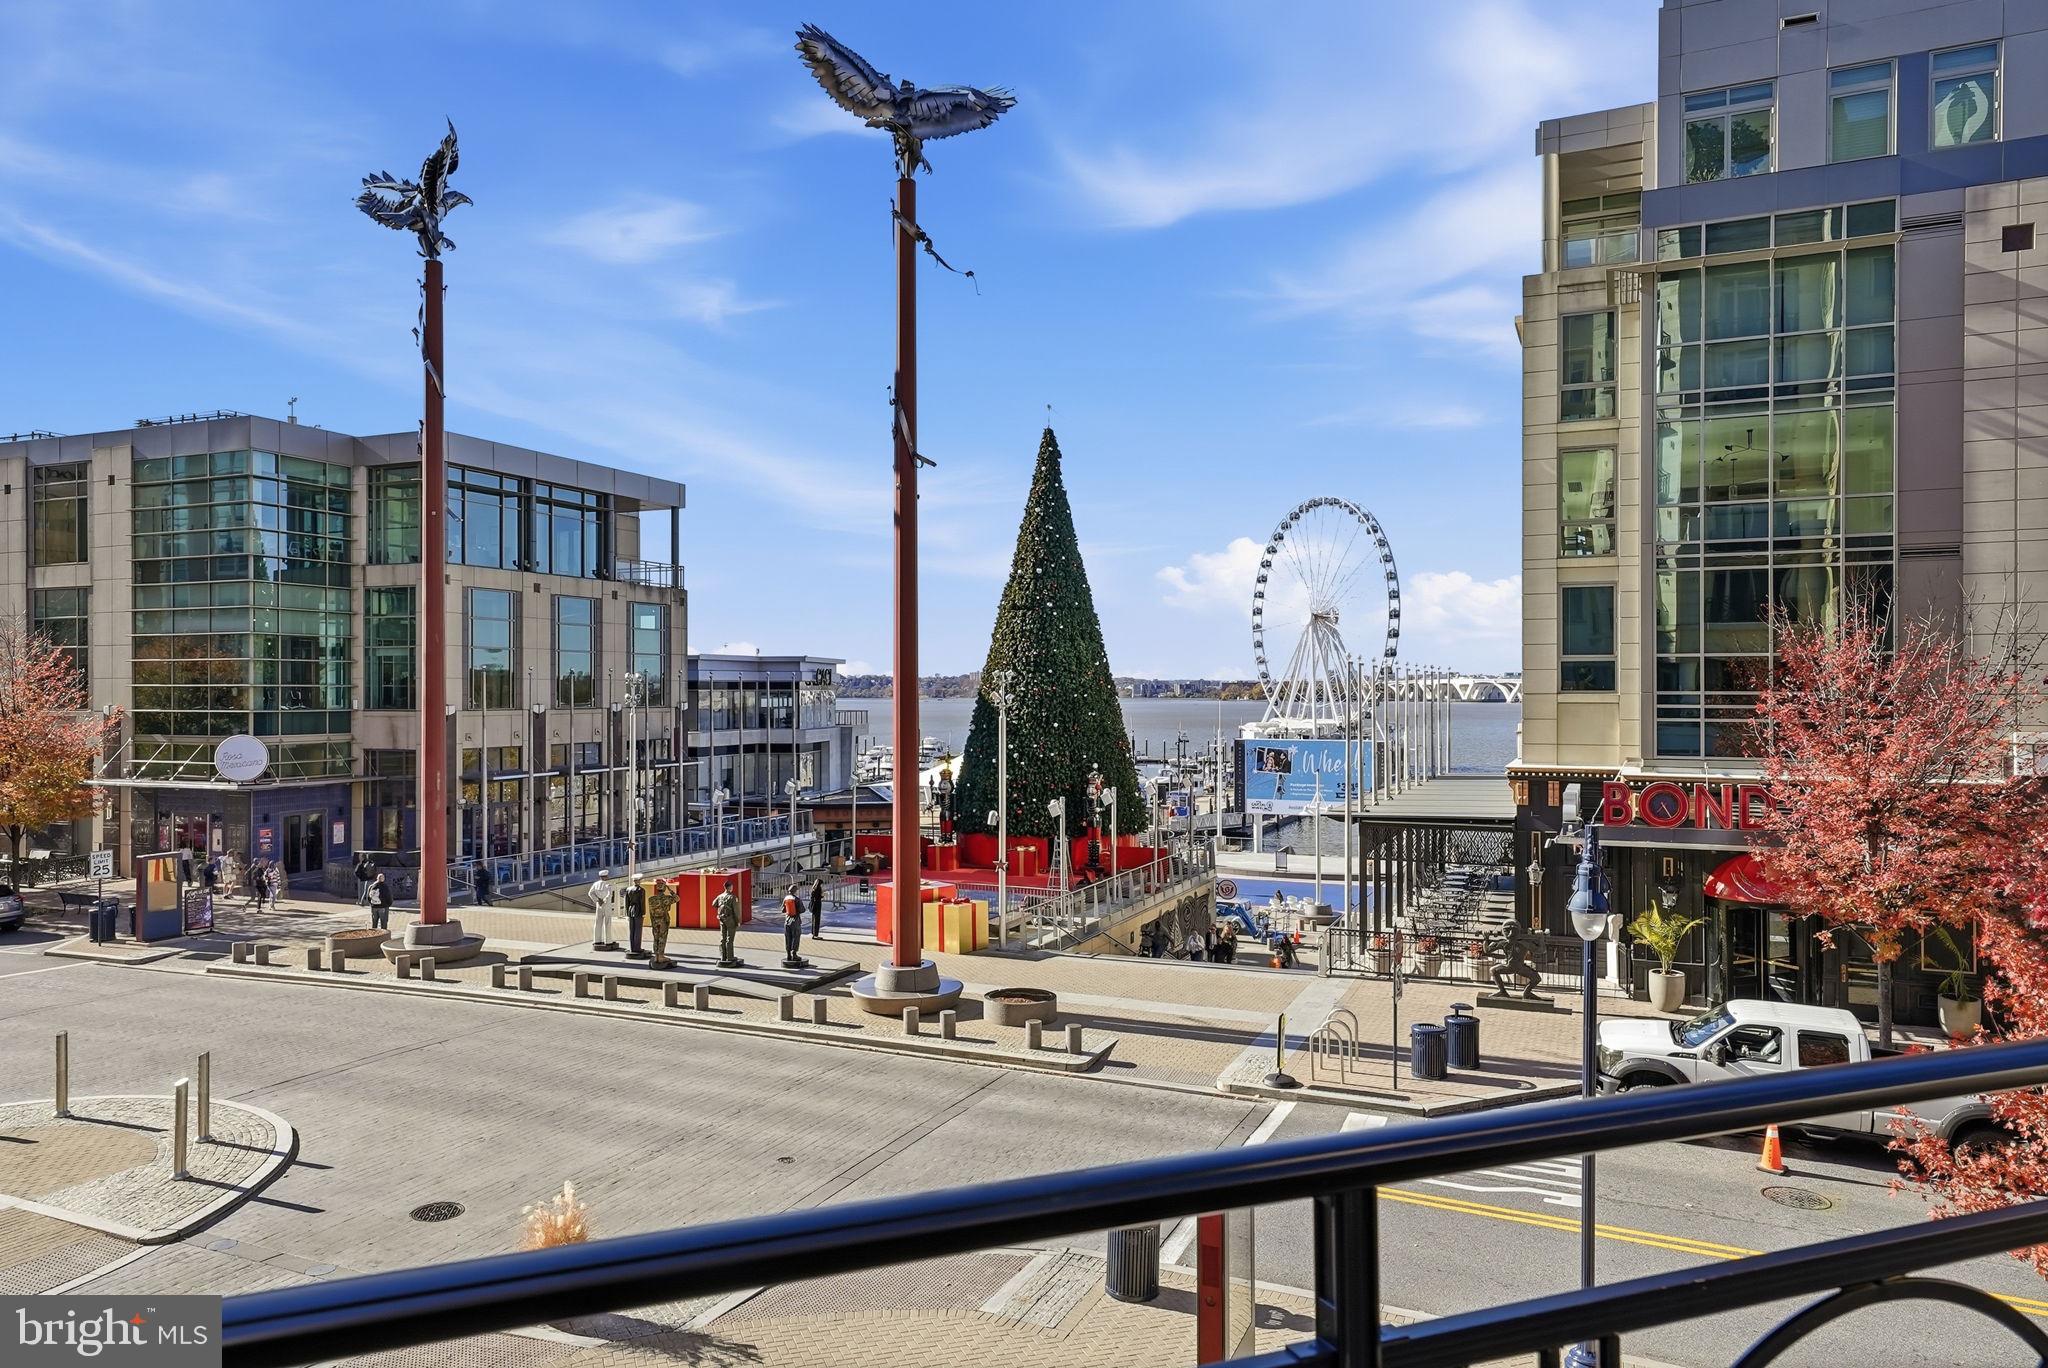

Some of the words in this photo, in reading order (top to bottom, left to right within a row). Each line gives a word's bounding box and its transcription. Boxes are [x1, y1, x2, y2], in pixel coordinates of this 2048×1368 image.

[222, 752, 243, 760] Rosa
[1603, 781, 1777, 830] BOND
[93, 865, 110, 876] 25
